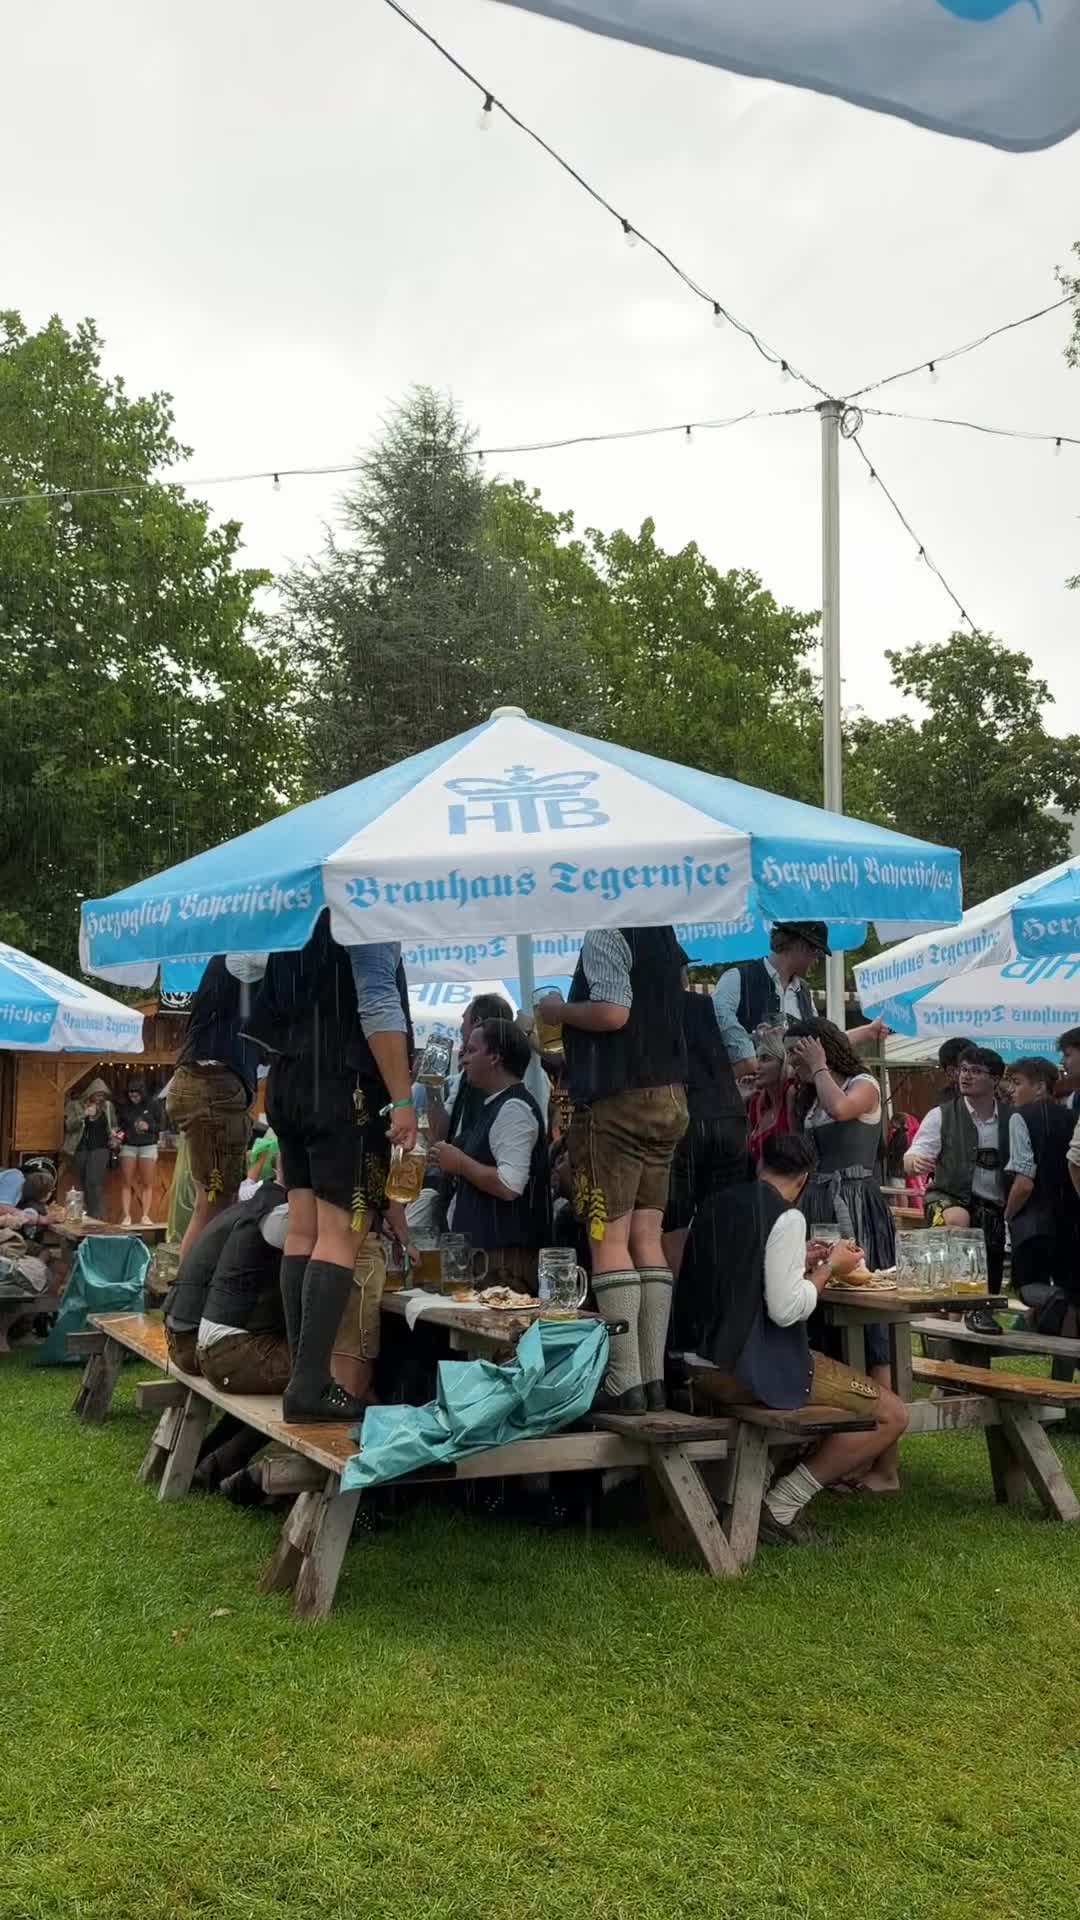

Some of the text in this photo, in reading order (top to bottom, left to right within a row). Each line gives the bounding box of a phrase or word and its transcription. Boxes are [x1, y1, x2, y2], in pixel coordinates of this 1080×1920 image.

[345, 856, 731, 911] Brauhaus Tegernsee
[762, 855, 860, 893] Herzoglich
[85, 897, 172, 939] Herzoglich
[859, 952, 924, 990] Brauhaus
